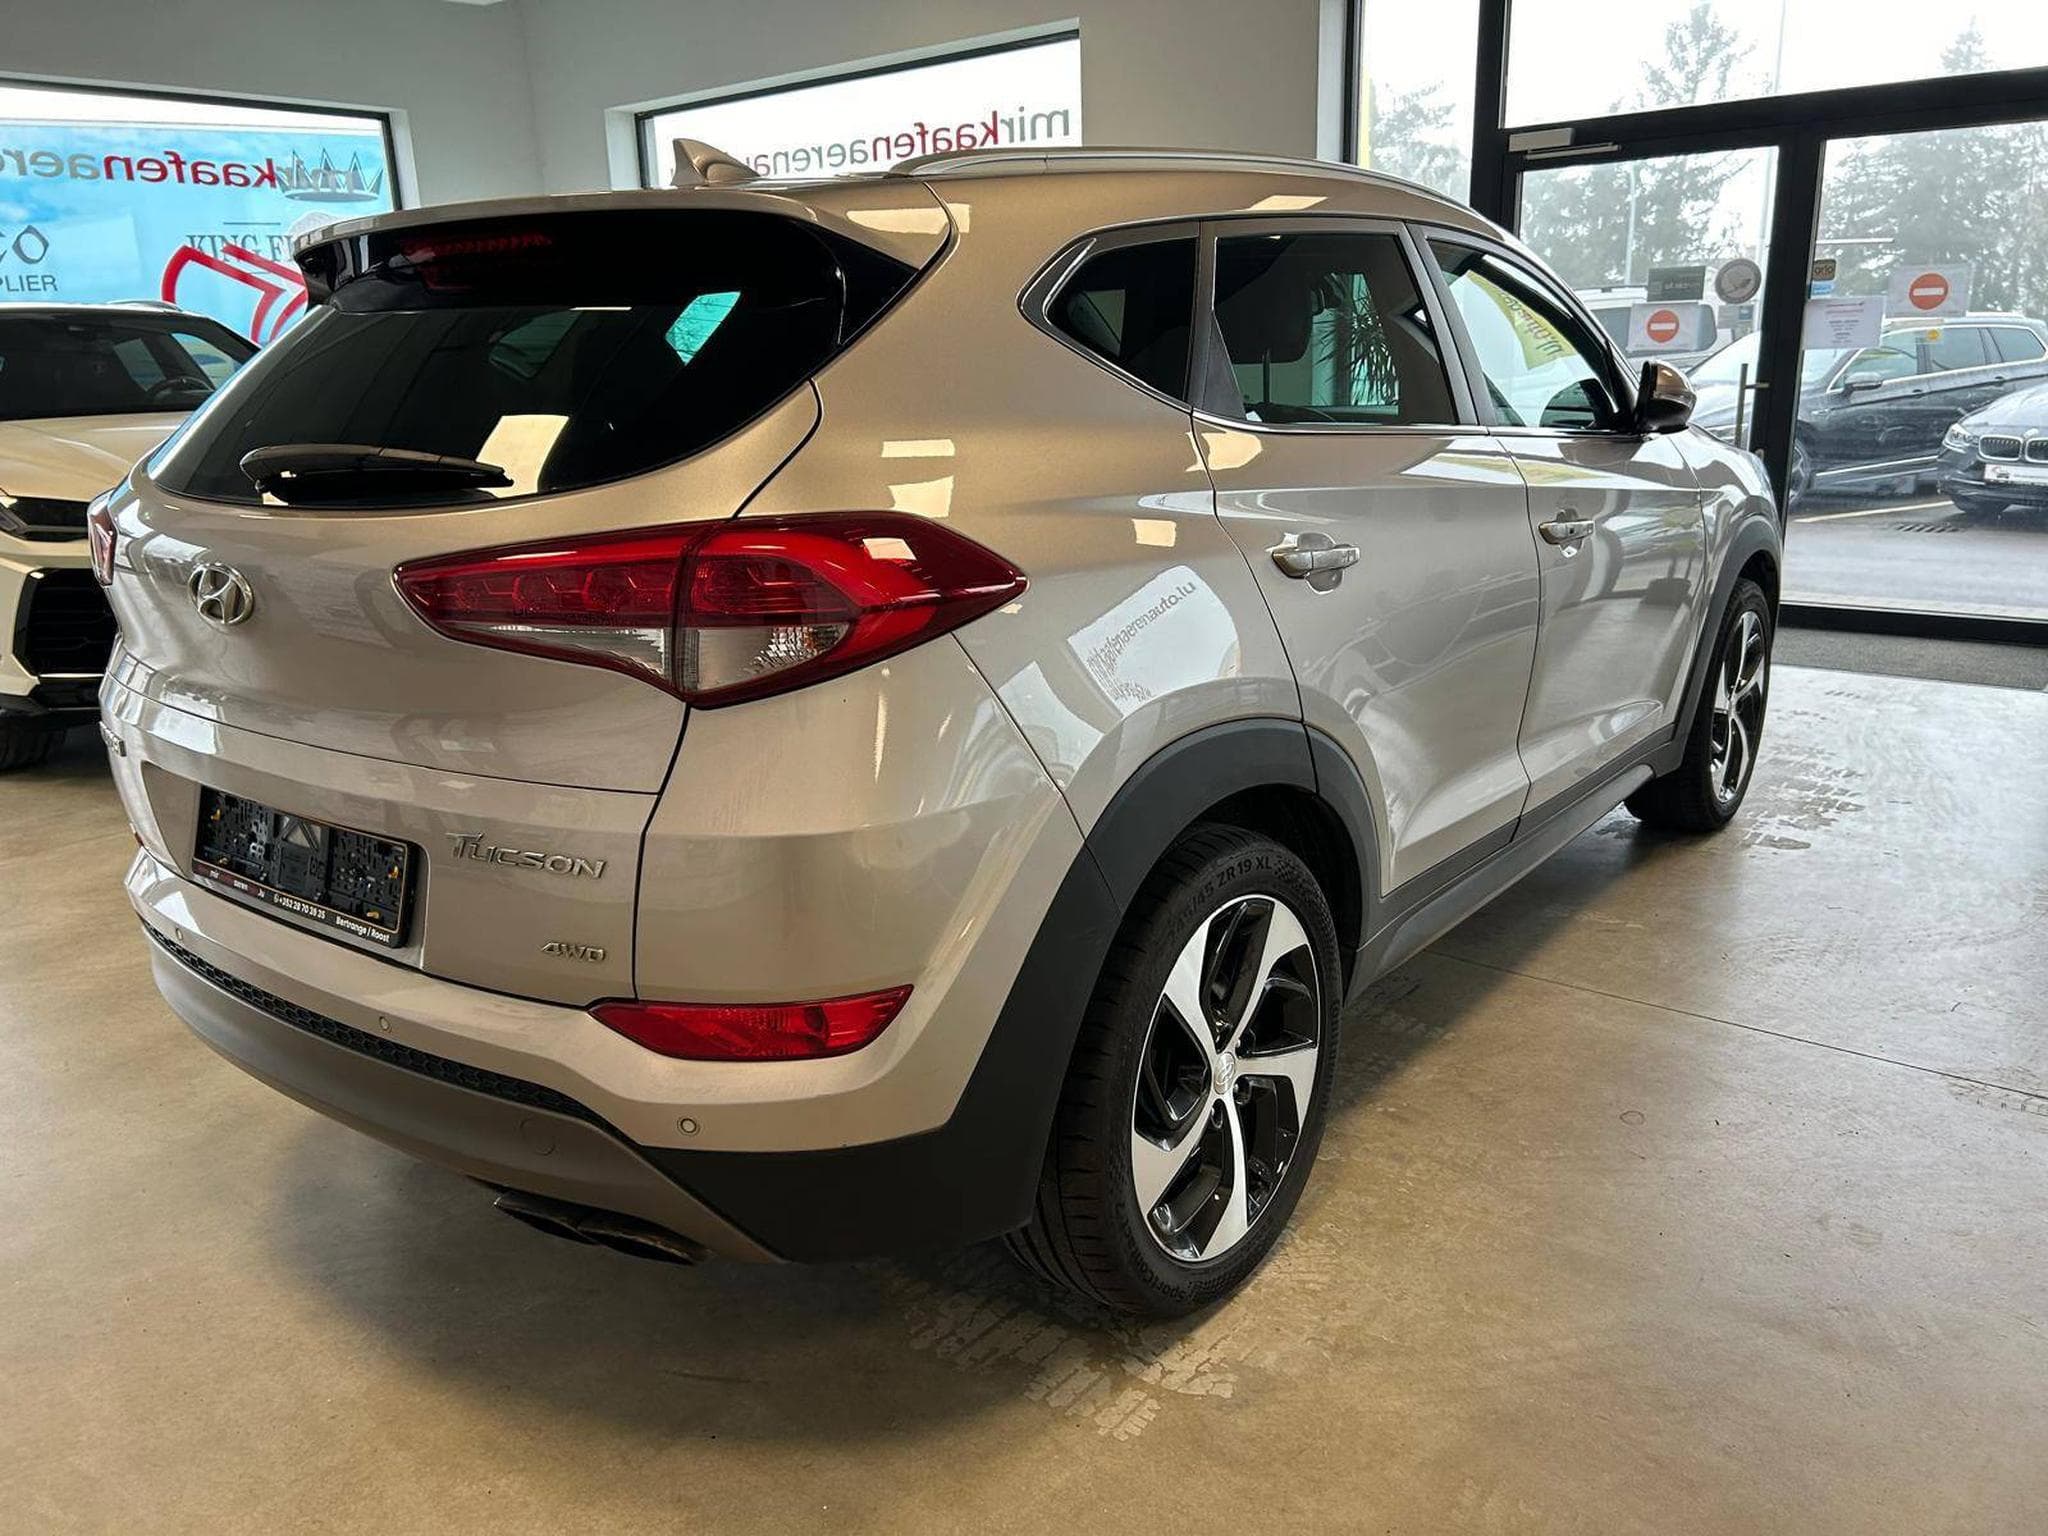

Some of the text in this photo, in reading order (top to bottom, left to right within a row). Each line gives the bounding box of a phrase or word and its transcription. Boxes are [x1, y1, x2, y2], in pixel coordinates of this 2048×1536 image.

[0, 274, 58, 292] LIER
[445, 832, 607, 878] TUCSON
[1237, 858, 1253, 876] 19
[1255, 855, 1273, 871] XL
[335, 916, 367, 936] Bertrange
[541, 941, 606, 962] 4WD
